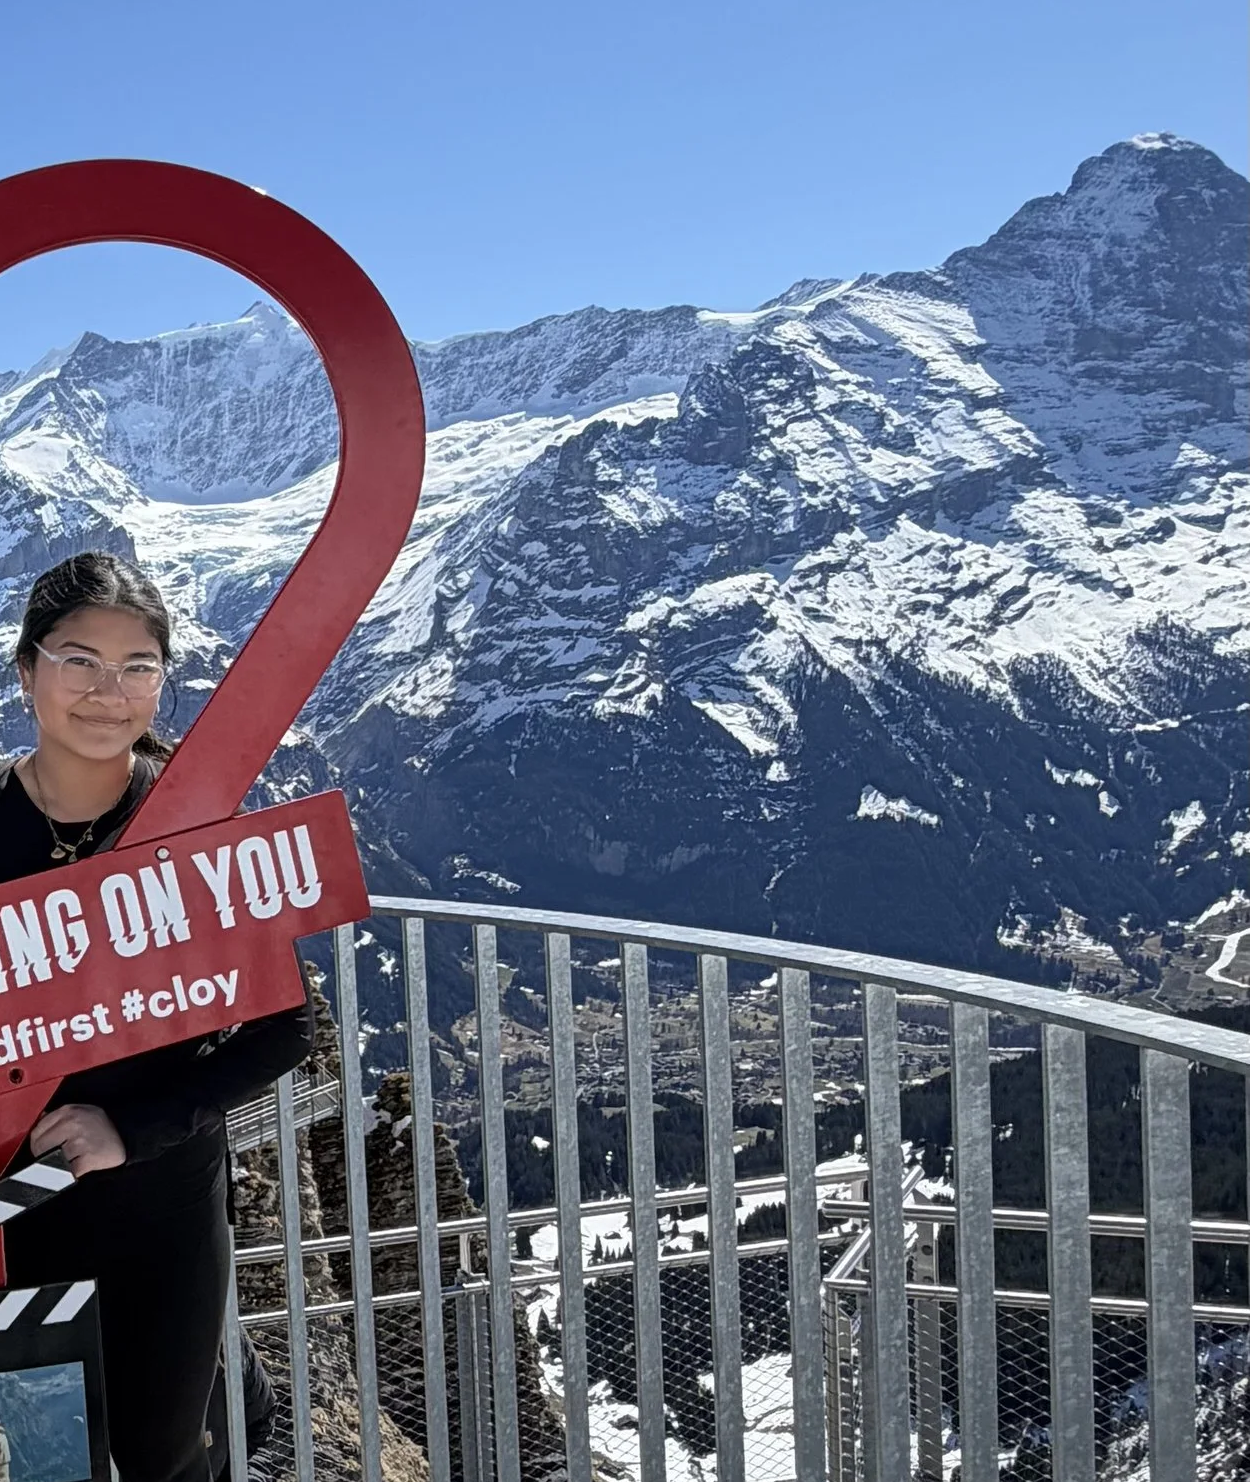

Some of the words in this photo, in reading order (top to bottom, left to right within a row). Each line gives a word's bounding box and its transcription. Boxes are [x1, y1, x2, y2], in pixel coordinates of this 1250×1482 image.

[100, 860, 191, 957] ON
[190, 825, 323, 929] YOU
[121, 969, 239, 1022] #cloy
